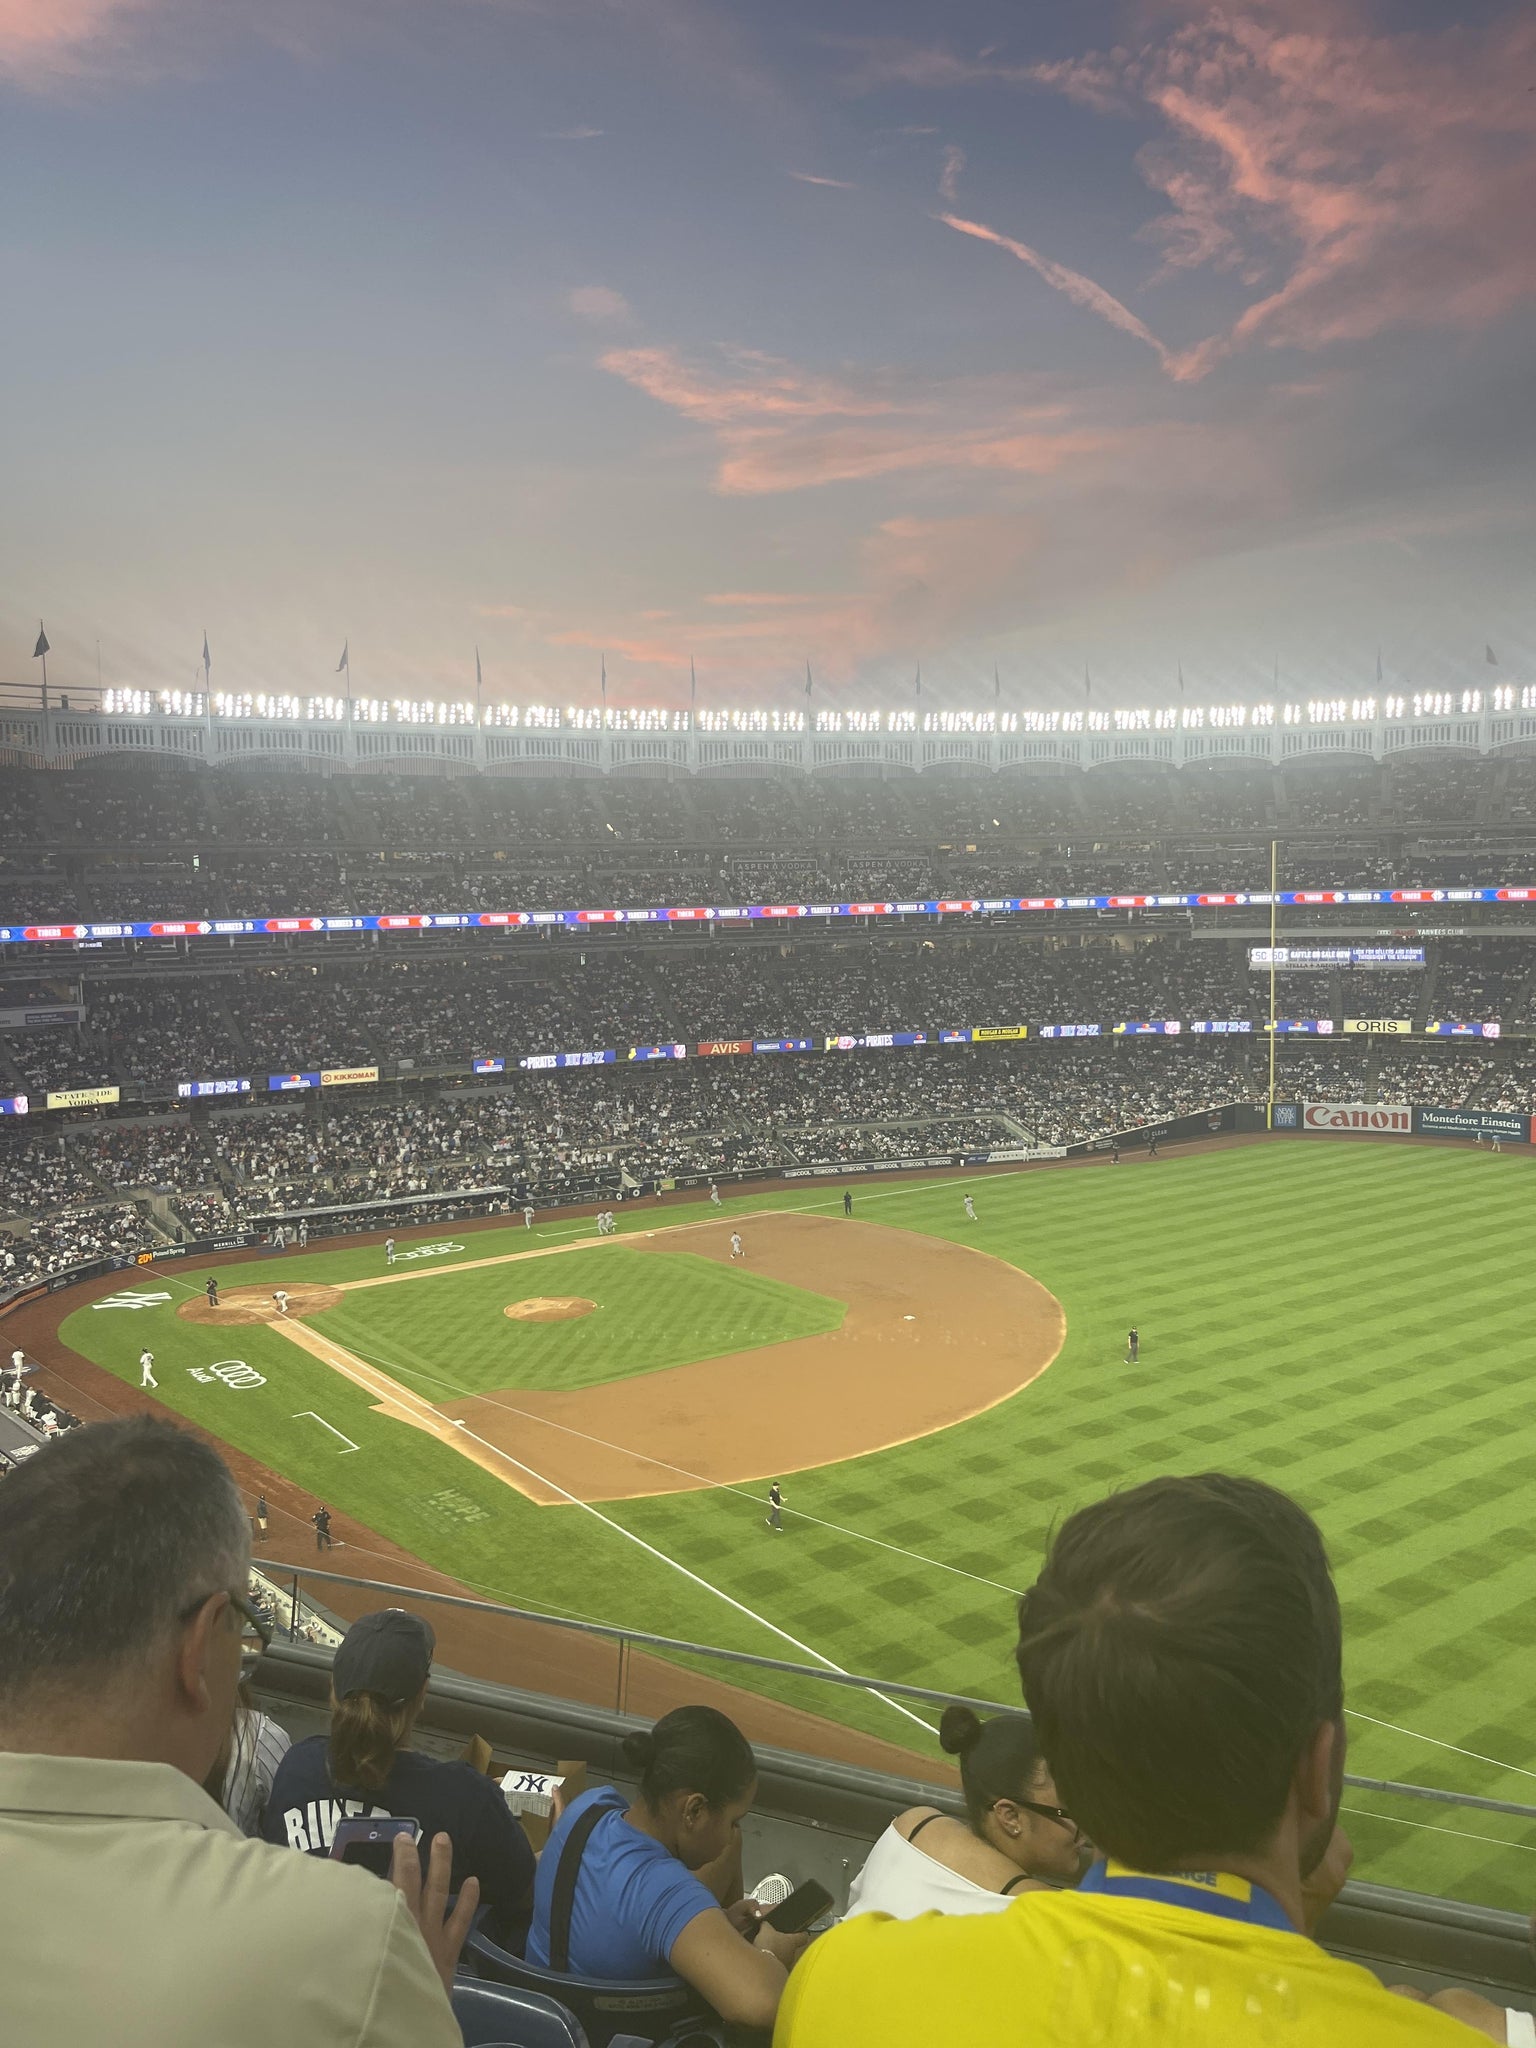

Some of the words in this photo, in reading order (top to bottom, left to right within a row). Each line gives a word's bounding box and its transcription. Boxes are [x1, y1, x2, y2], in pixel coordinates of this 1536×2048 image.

[1321, 950, 1335, 958] SALE
[1043, 1026, 1055, 1037] PIT
[1060, 1025, 1076, 1036] JULY
[1195, 1022, 1206, 1032] PIT
[1212, 1022, 1227, 1032] JULY
[1356, 1021, 1398, 1032] ORIS
[866, 1035, 893, 1047] PIRATES
[711, 1043, 740, 1054] AVIS
[527, 1055, 556, 1069] PIRATES
[565, 1053, 581, 1066] JULY
[334, 1072, 375, 1081] KIKKOMAN
[55, 1090, 113, 1100] STATESIDE
[178, 1084, 192, 1097] PIT
[198, 1082, 214, 1095] JULY
[68, 1099, 100, 1107] VODKA
[1305, 1106, 1408, 1129] Canon
[1422, 1113, 1478, 1125] Montefiore
[1481, 1117, 1521, 1128] Einstein
[1151, 1129, 1167, 1137] CLEAR
[153, 1250, 170, 1258] Poland
[170, 1248, 186, 1256] Spring
[186, 1367, 217, 1383] Audi
[284, 1799, 424, 1855] RIV
